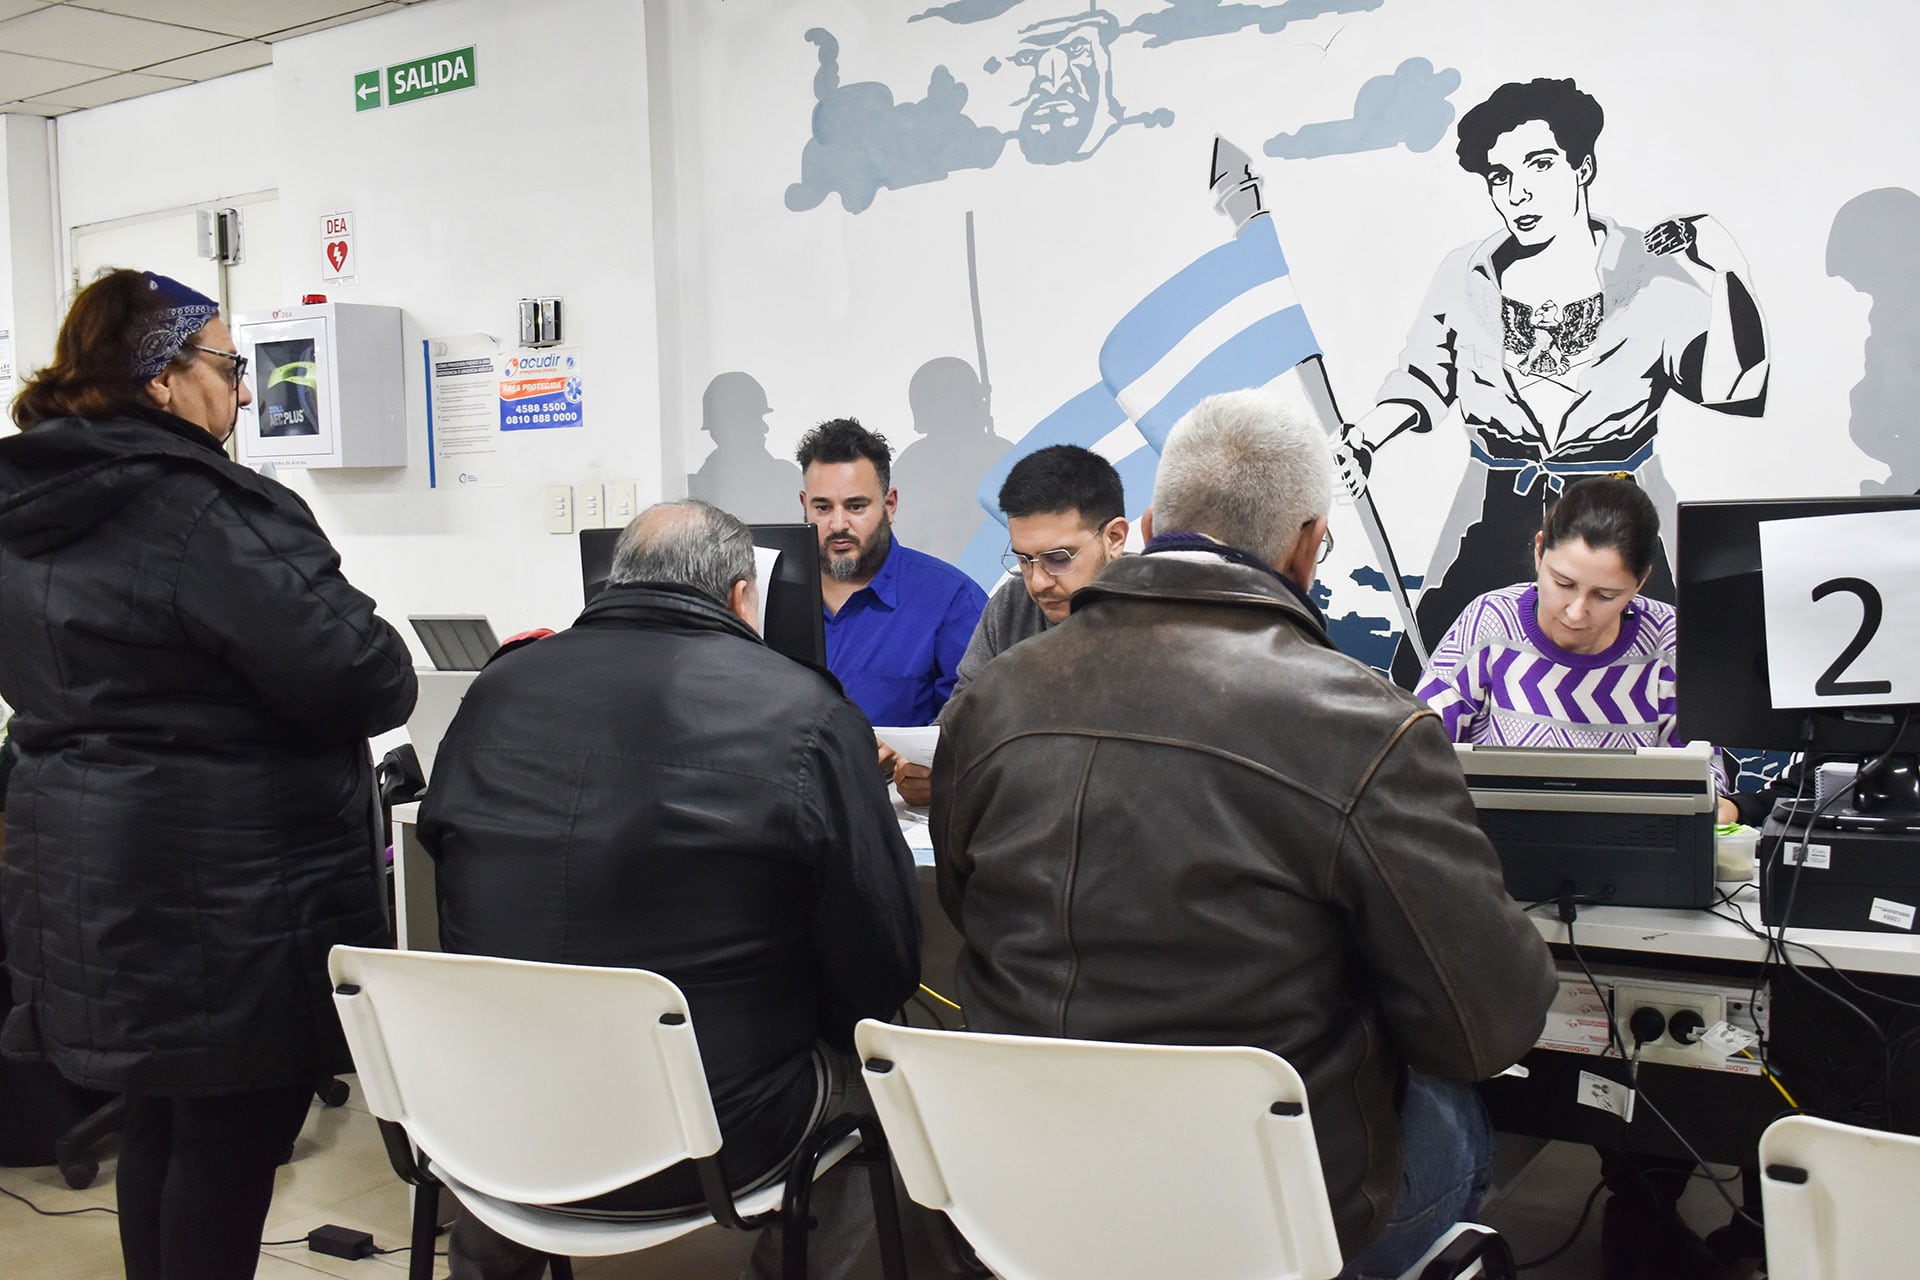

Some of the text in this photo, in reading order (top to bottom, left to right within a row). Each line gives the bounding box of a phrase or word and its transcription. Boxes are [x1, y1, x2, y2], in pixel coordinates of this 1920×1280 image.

[394, 55, 468, 95] SALIDA
[326, 217, 347, 234] DEA
[519, 352, 561, 369] acudir
[522, 381, 562, 392] PROTEGIDA
[515, 402, 567, 414] 4588 5500
[283, 410, 304, 425] PLUS
[505, 411, 577, 424] 0810 888 0000
[1811, 577, 1892, 696] 2
